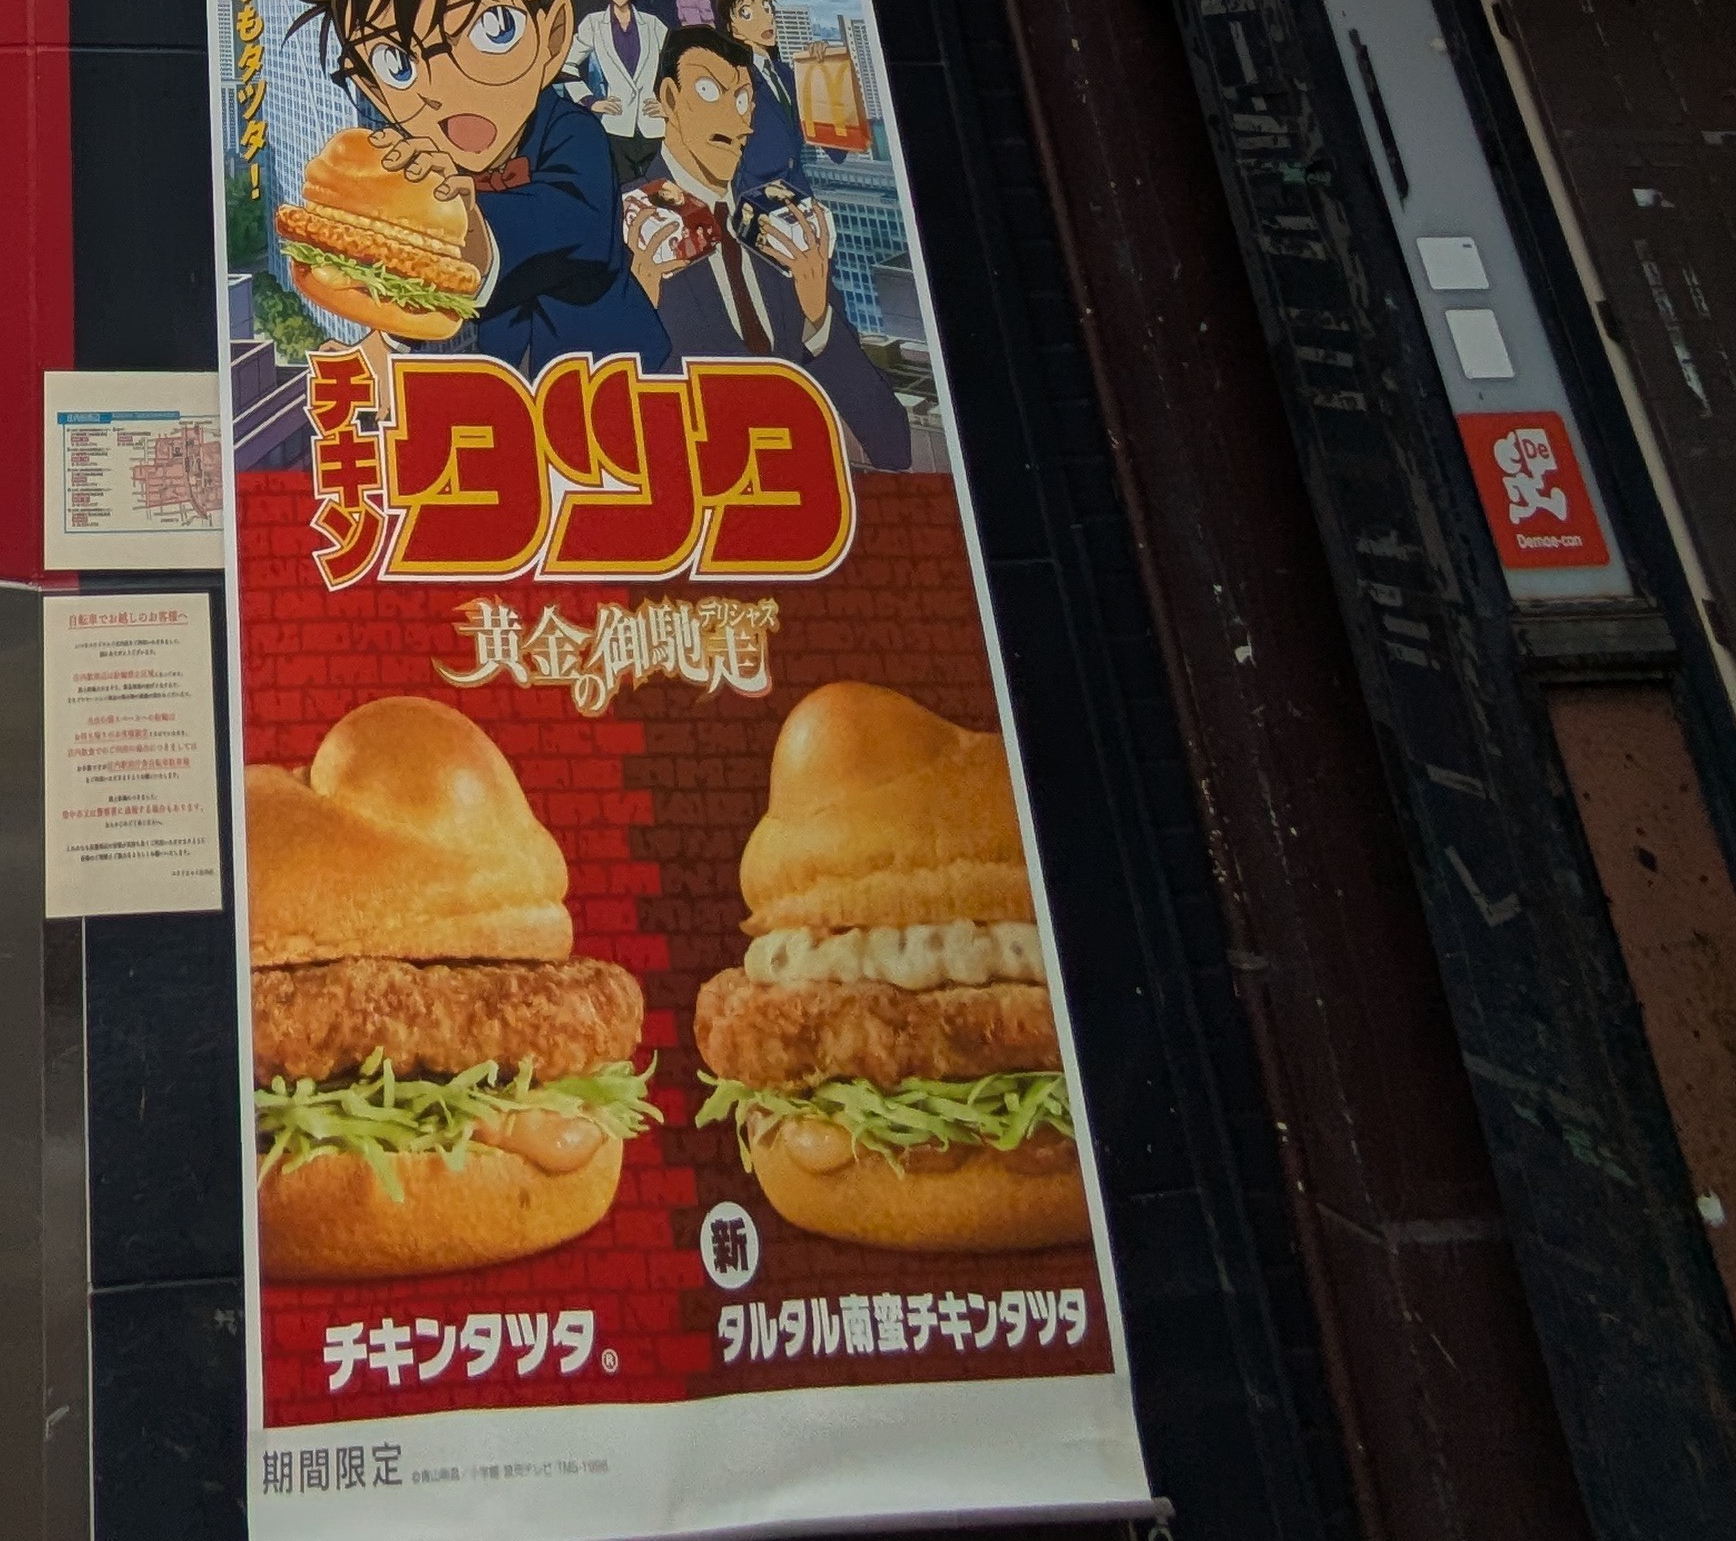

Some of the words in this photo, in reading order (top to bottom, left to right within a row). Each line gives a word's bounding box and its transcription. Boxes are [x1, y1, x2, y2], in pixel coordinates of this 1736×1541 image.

[307, 350, 384, 590] チキン
[382, 353, 855, 581] タツタ
[1521, 439, 1550, 459] De
[1516, 534, 1582, 548] Demae-can
[699, 601, 776, 627] デリシャス
[436, 600, 768, 711] 黄金の御馳走
[712, 1218, 751, 1276] 新
[718, 1287, 1085, 1362] タルタル南蛮チキンタツタ
[262, 1442, 403, 1495] 期間限定
